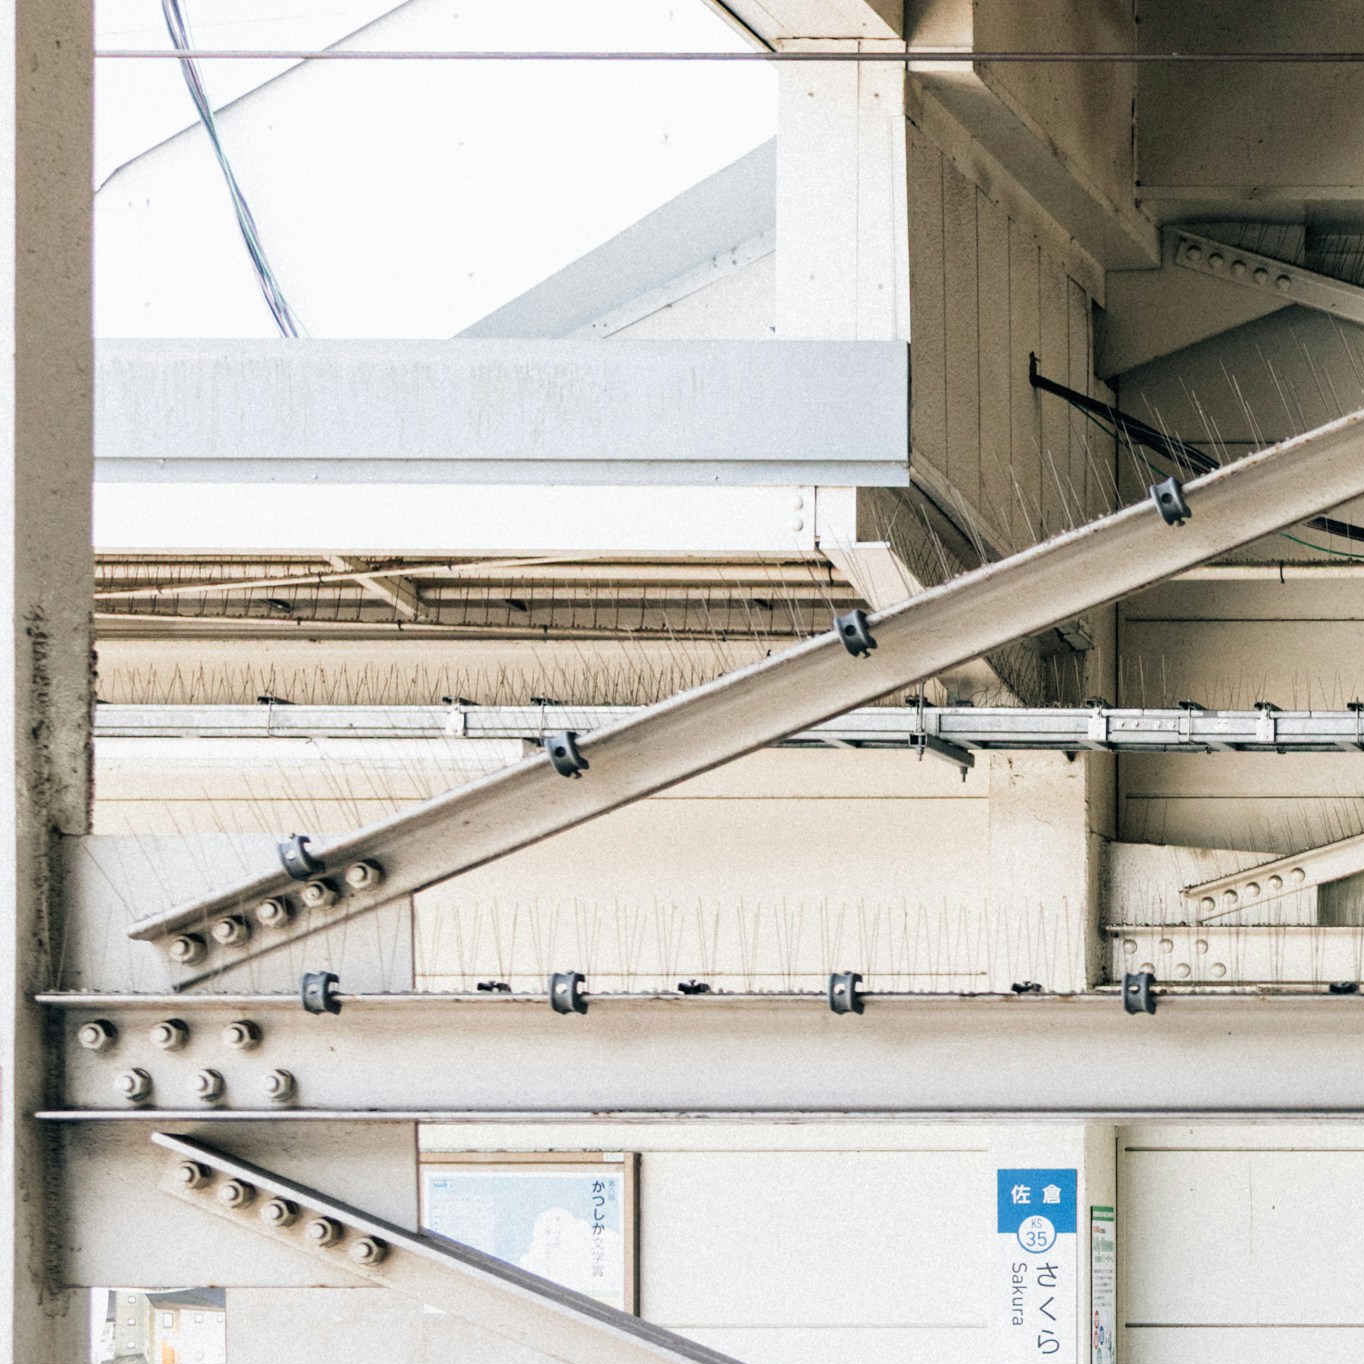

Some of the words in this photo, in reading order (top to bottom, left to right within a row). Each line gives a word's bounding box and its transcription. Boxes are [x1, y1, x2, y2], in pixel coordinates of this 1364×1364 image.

[1011, 1184, 1062, 1205] 佐倉
[1031, 1218, 1043, 1229] KS
[1026, 1231, 1048, 1247] 35
[1012, 1262, 1028, 1326] Sakura
[1036, 1262, 1061, 1355] さくら
